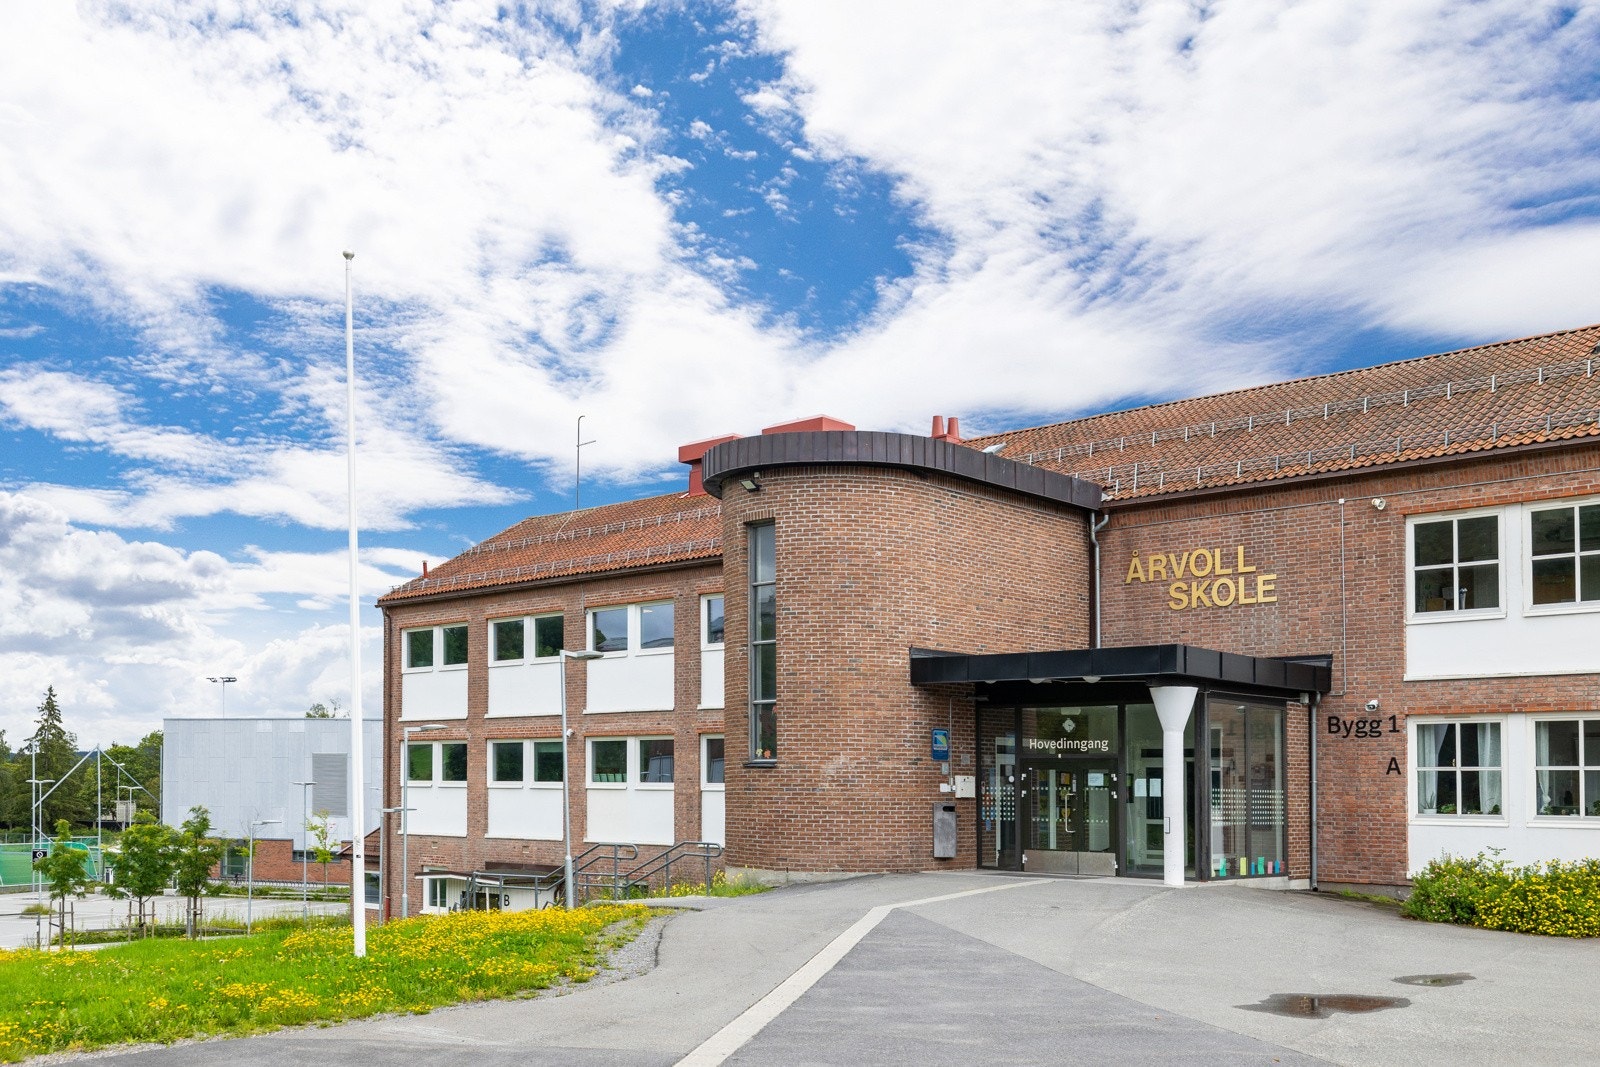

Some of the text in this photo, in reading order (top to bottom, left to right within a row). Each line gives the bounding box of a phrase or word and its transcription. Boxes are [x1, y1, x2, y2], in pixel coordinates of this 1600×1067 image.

[1125, 545, 1257, 584] ÅRVOLL
[1168, 573, 1278, 611] SKOLE
[1327, 714, 1400, 739] Bygg 1
[1029, 737, 1109, 752] Hovedinngang
[1385, 756, 1402, 775] A
[504, 894, 510, 906] B
